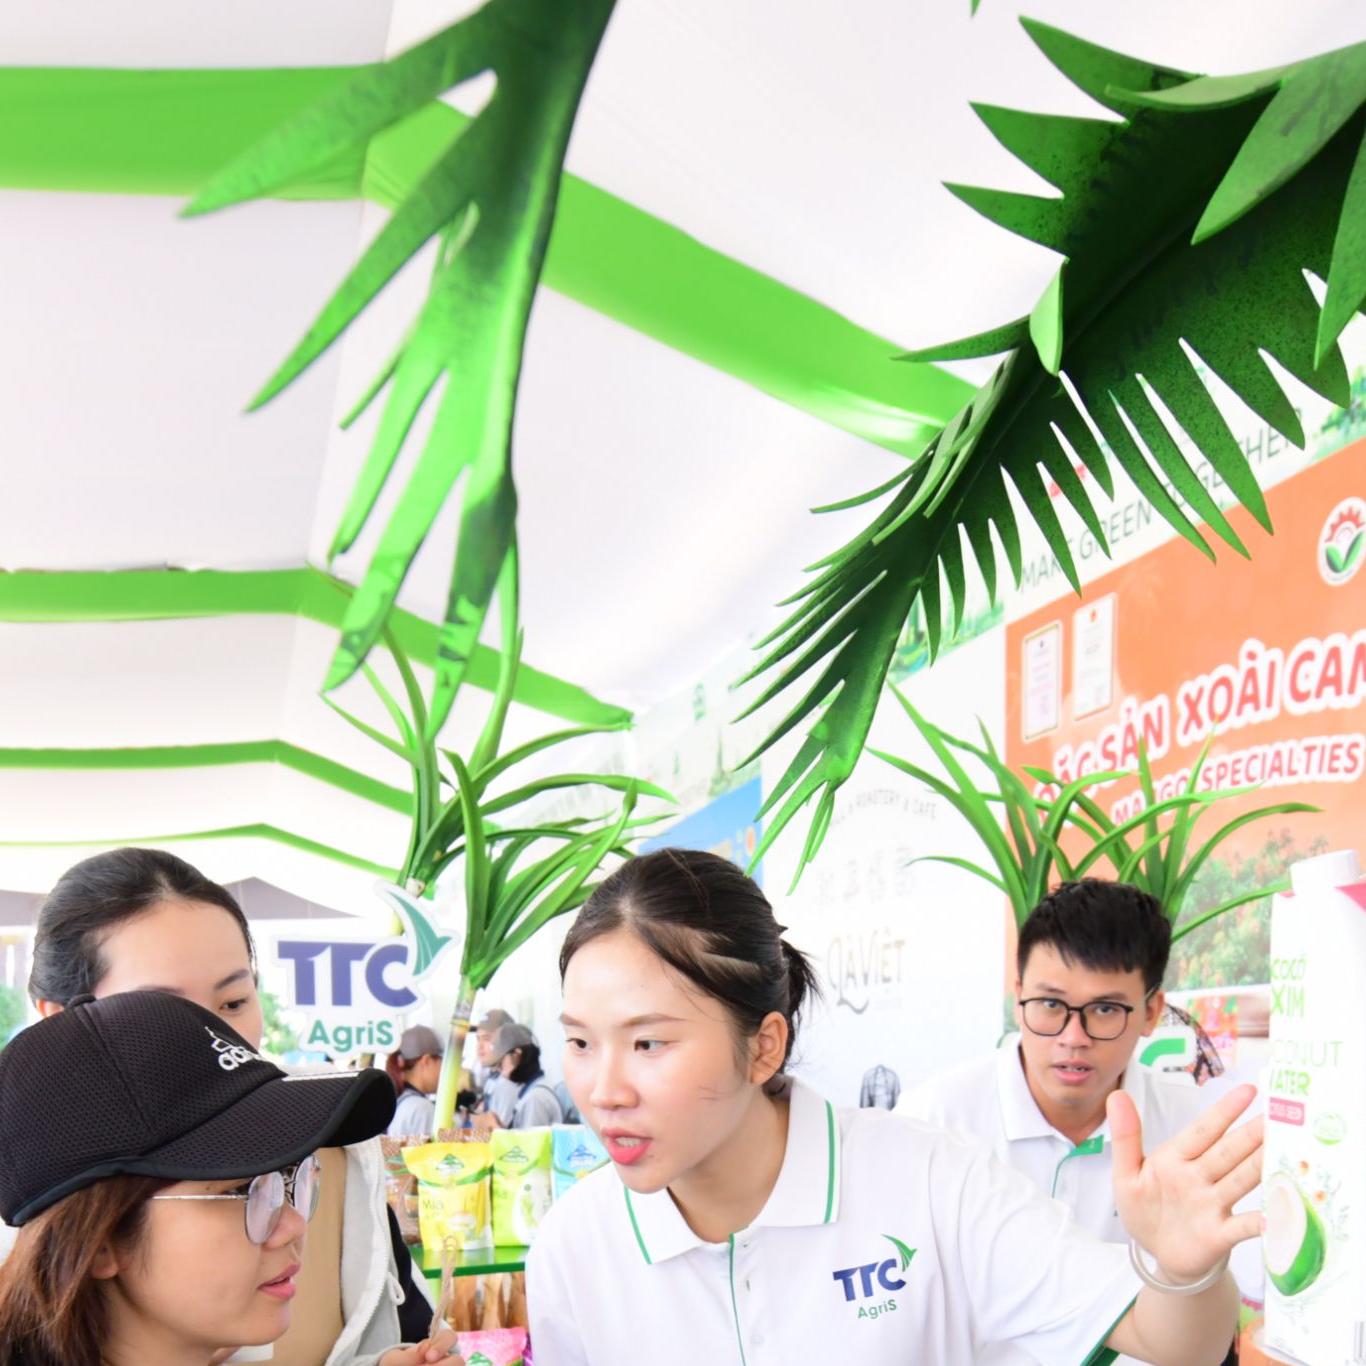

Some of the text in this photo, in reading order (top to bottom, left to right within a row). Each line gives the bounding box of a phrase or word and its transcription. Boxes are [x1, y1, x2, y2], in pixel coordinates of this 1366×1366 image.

[1183, 652, 1277, 737] XOÀI
[1202, 741, 1362, 792] SPECIALTIES
[278, 940, 418, 1007] TTC
[308, 1019, 393, 1052] AgriS
[832, 1258, 907, 1302] TTC
[858, 1299, 897, 1319] AgriS
